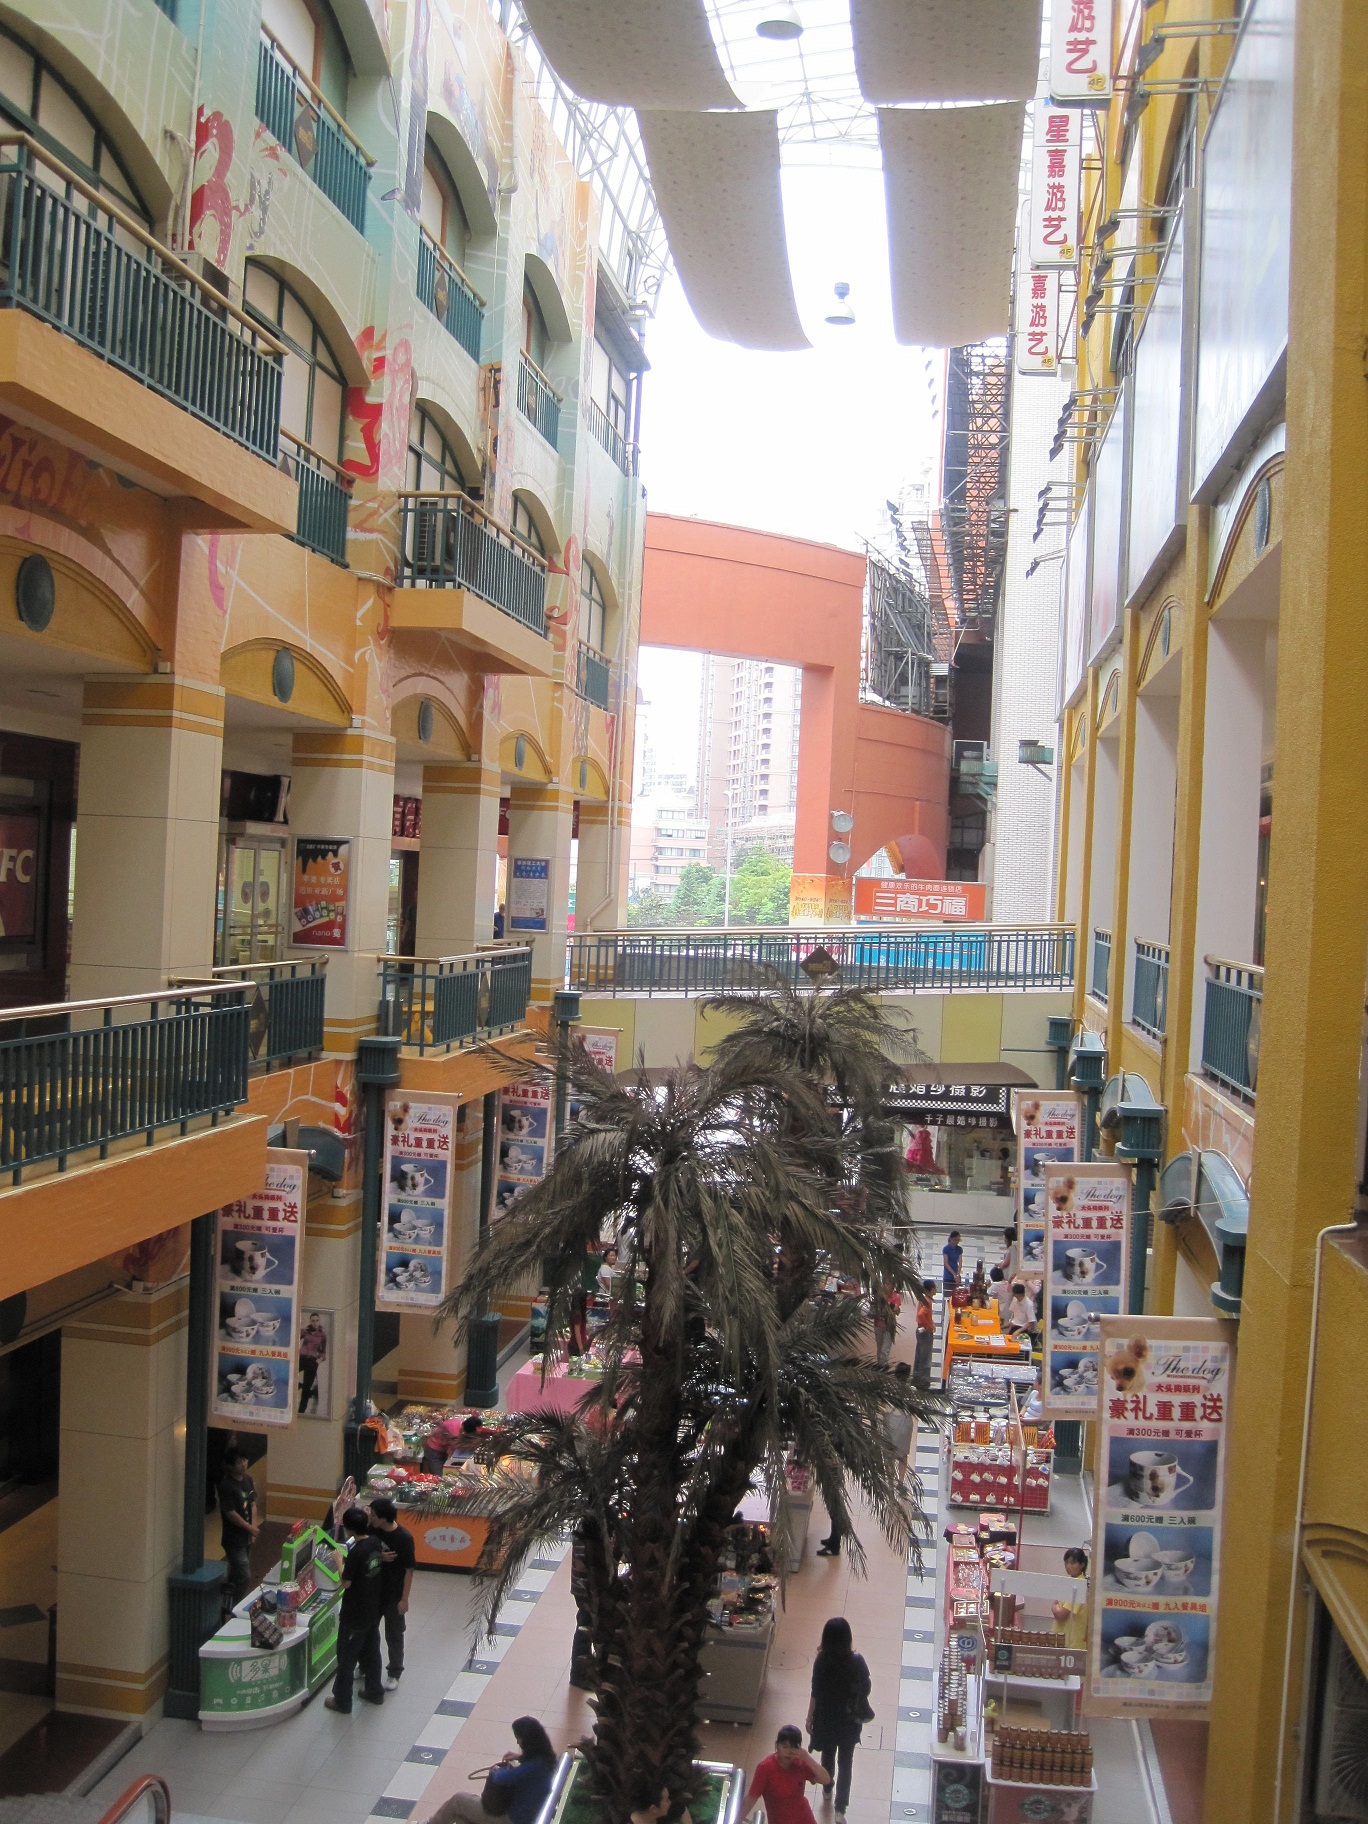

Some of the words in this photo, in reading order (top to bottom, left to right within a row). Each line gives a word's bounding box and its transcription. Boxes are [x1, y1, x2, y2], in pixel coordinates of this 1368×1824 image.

[1042, 114, 1071, 246] 星嘉游艺
[0, 848, 34, 884] FC
[874, 892, 967, 916] 三商巧福
[391, 1132, 449, 1151] 豪礼重重送
[276, 1177, 297, 1195] dog
[1078, 1186, 1101, 1202] The
[1102, 1189, 1123, 1204] dog
[222, 1201, 298, 1223] 豪礼重重送
[1052, 1210, 1124, 1230] 豪礼重重送
[1152, 1354, 1190, 1378] The
[1191, 1359, 1225, 1384] dog
[1108, 1393, 1223, 1423] 豪礼重重送
[1126, 1427, 1170, 1438] 满300元赠
[1175, 1429, 1203, 1439] 可爱杯
[1121, 1513, 1164, 1524] 满600元赠
[1059, 1655, 1075, 1668] 10
